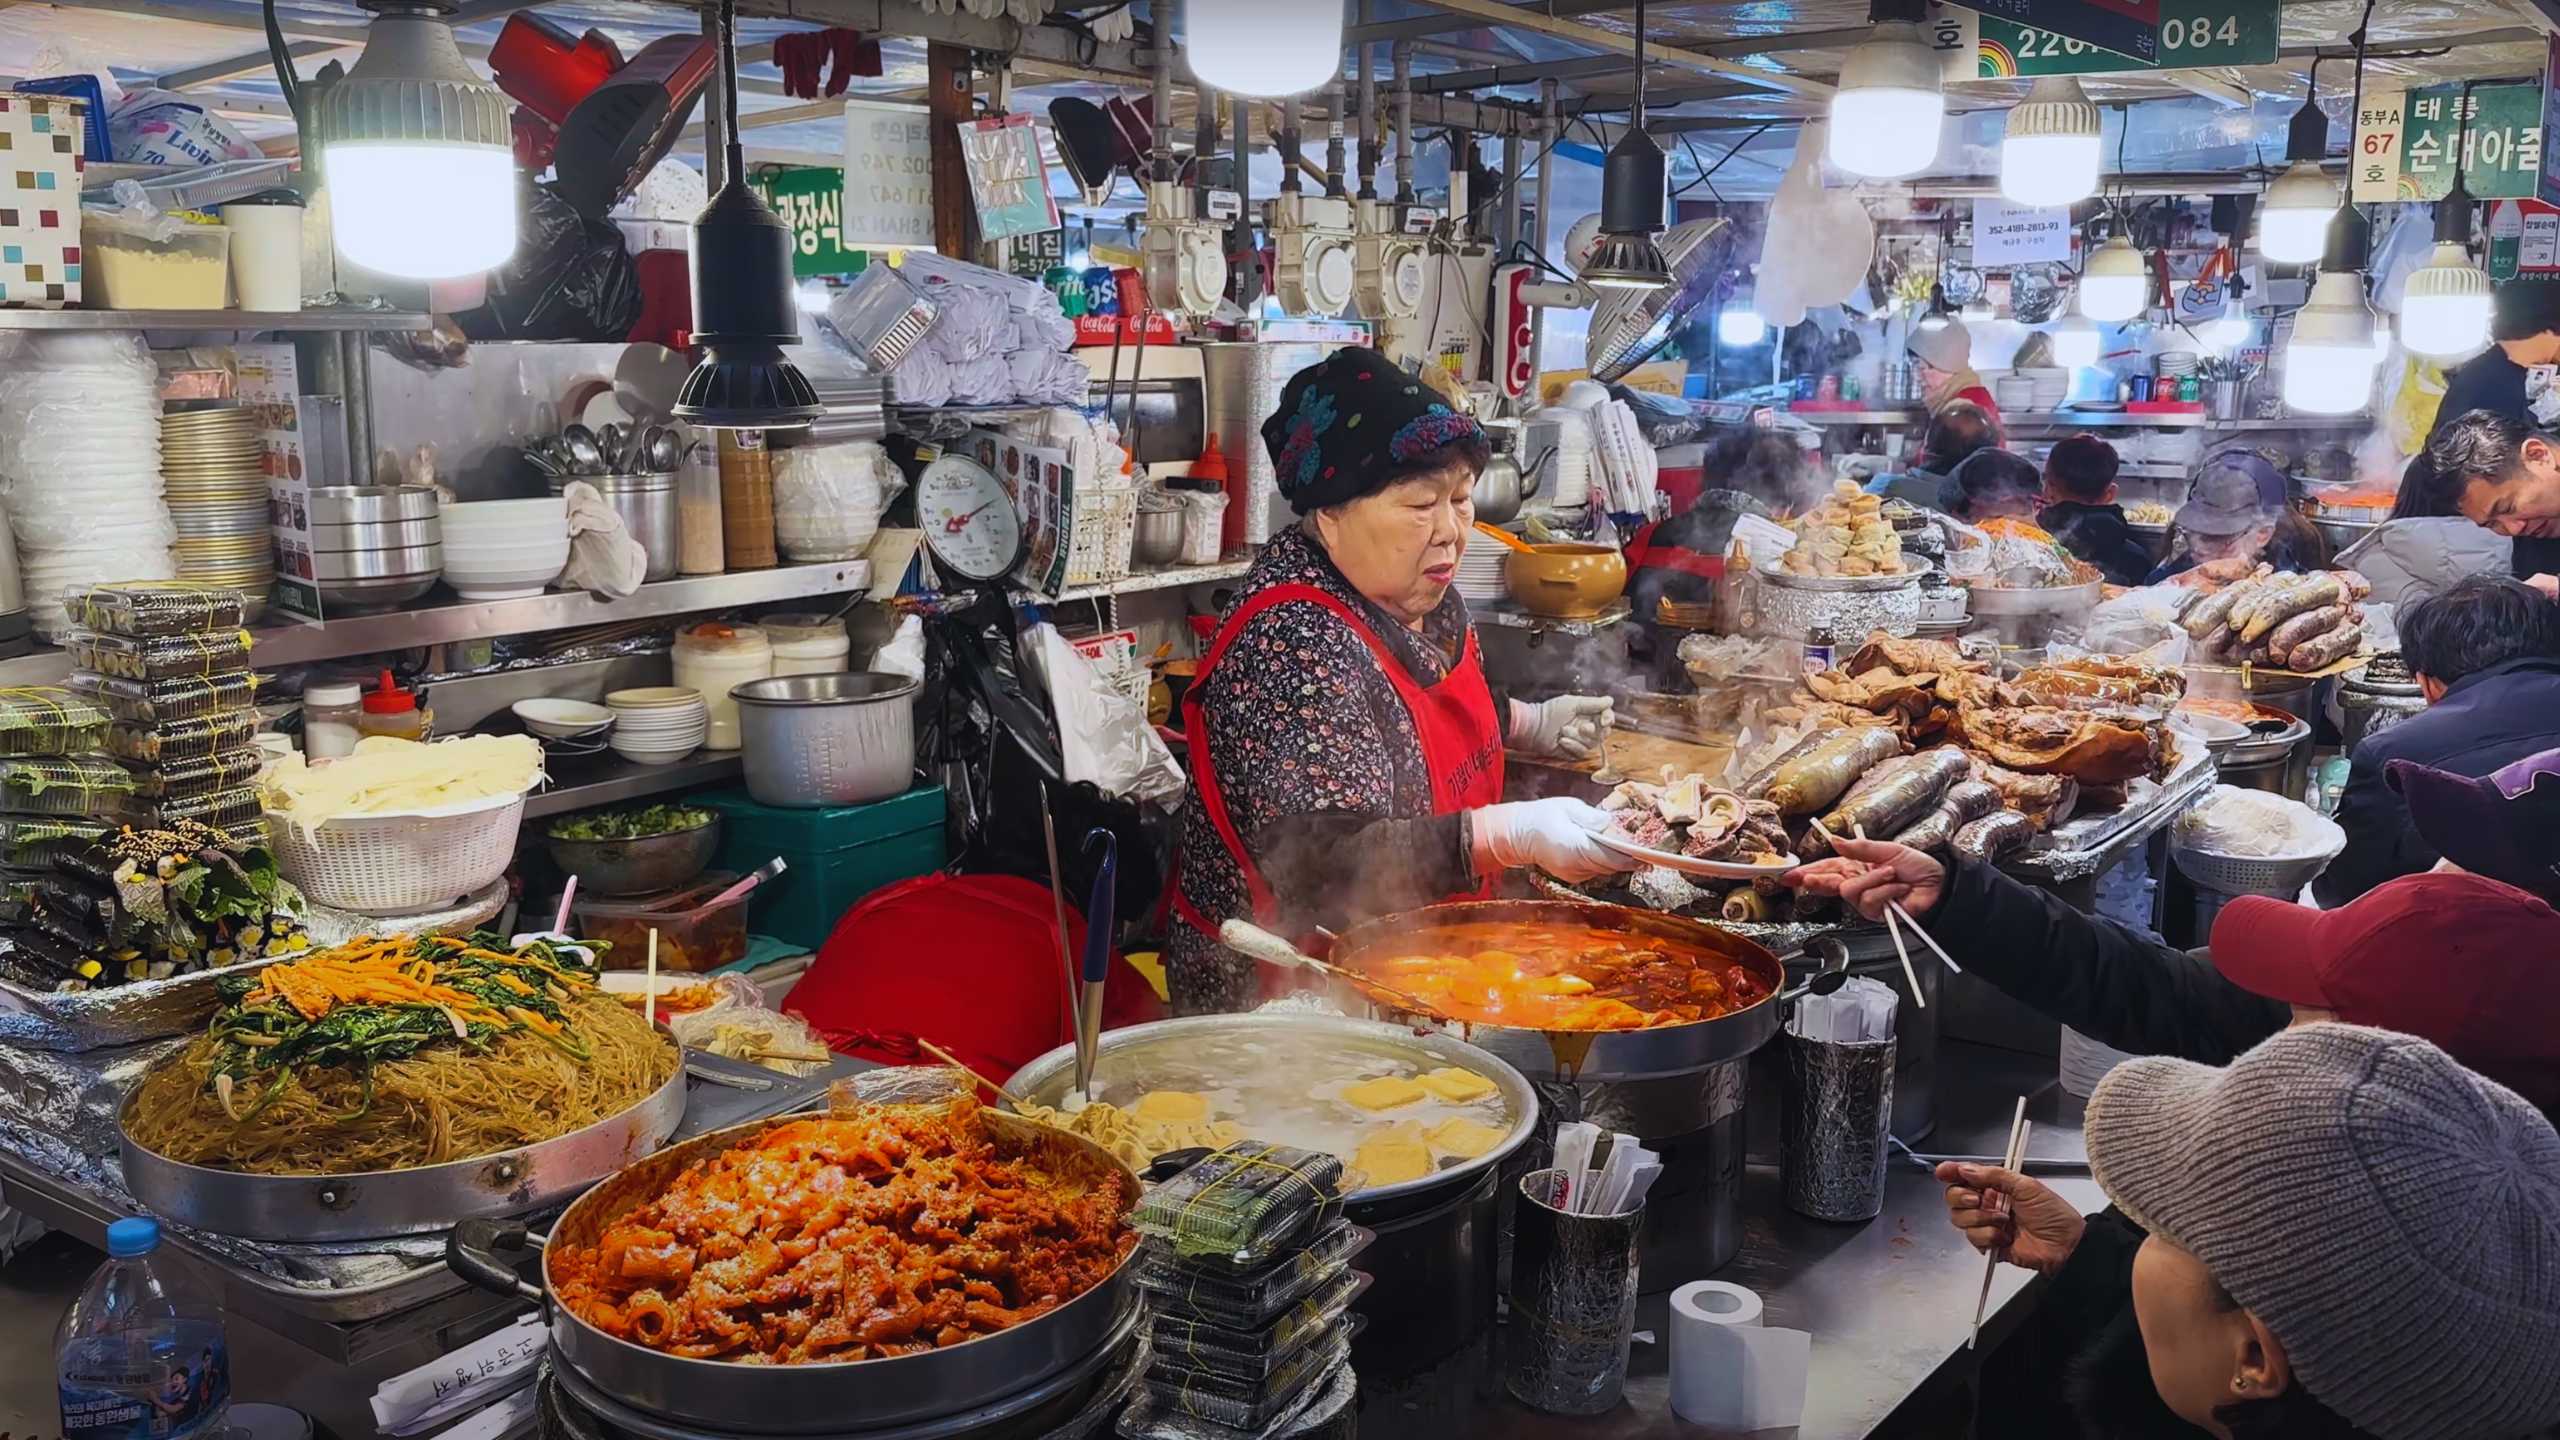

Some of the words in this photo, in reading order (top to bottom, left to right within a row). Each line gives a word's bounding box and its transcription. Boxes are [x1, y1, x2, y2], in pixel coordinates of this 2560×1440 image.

[1932, 20, 1964, 49] 호
[2363, 133, 2395, 155] 67
[2363, 164, 2385, 183] 호
